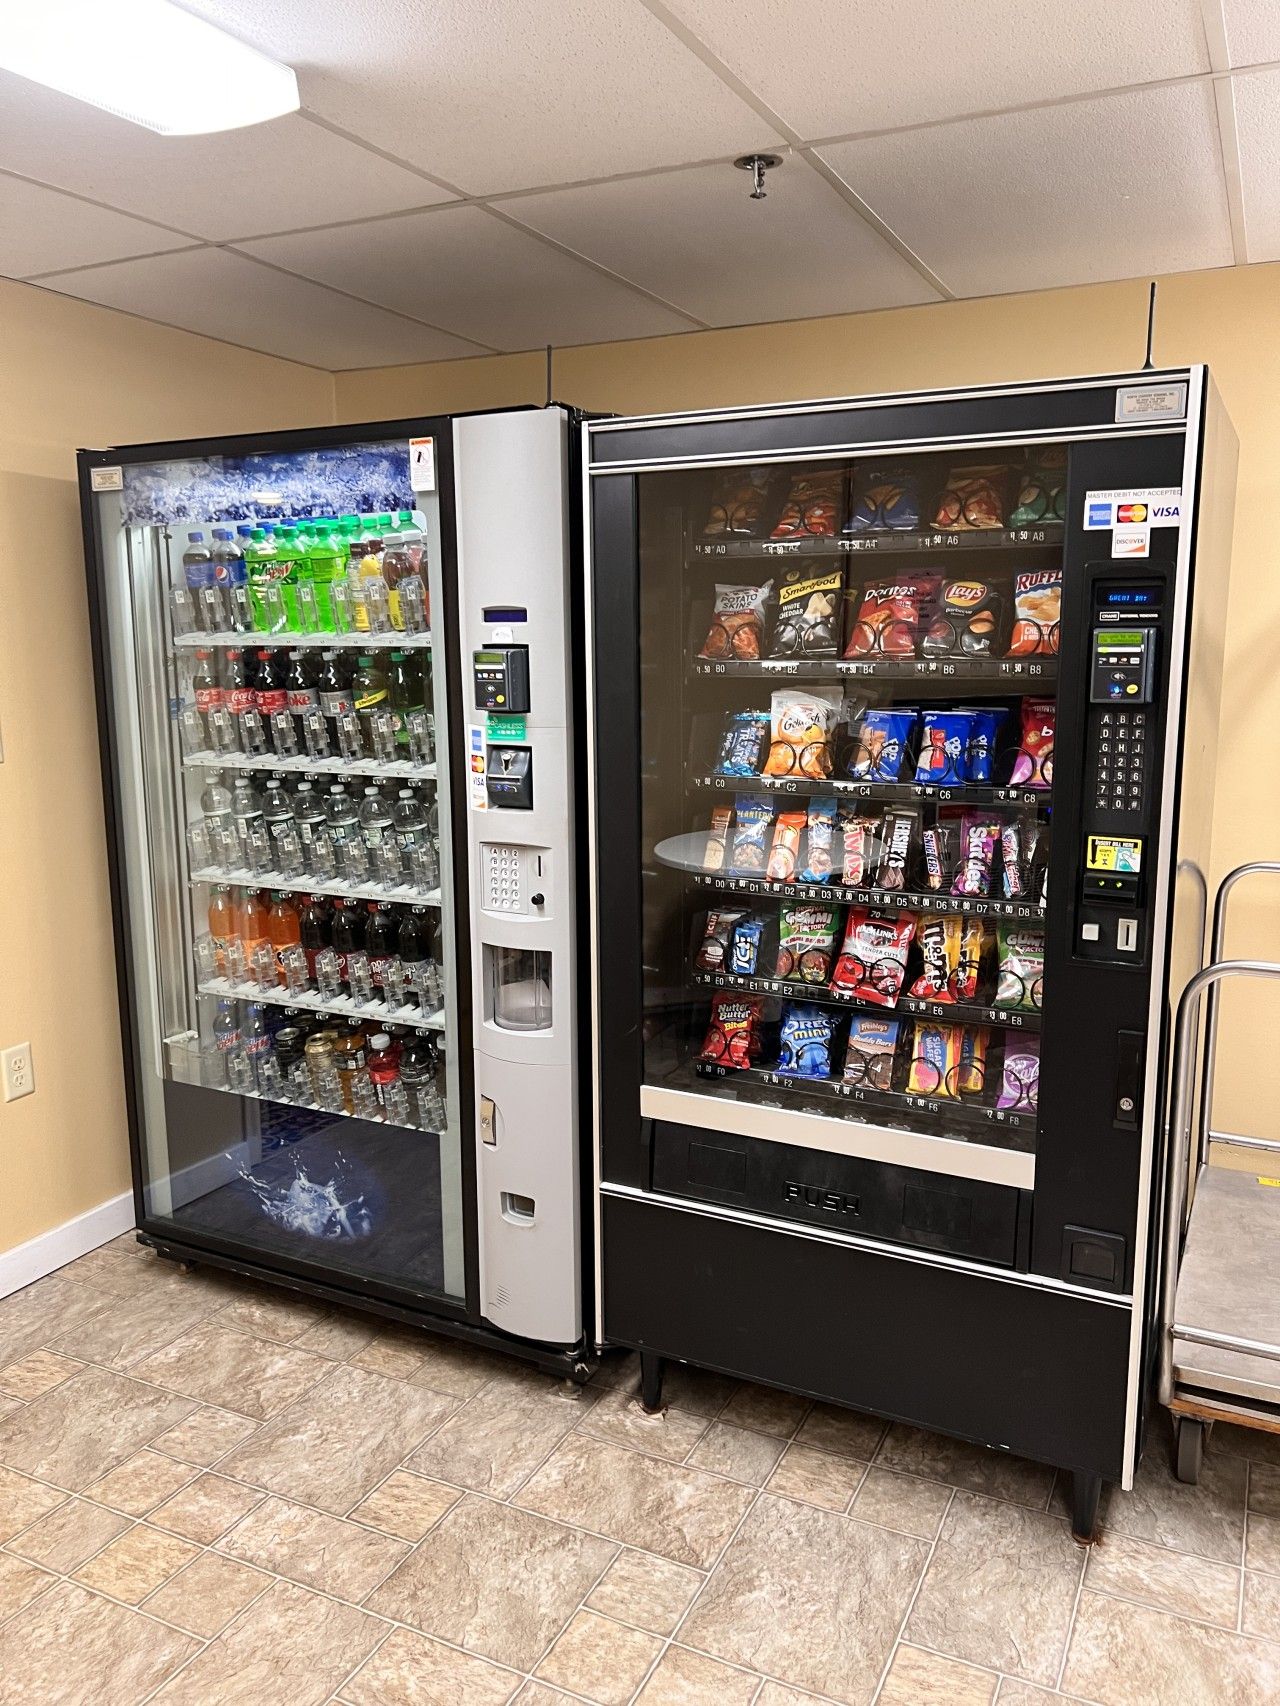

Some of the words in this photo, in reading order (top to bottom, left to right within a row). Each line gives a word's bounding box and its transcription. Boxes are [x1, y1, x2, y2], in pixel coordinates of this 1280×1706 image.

[1113, 491, 1132, 499] DEBIT
[1132, 490, 1146, 498] NOT
[1152, 506, 1180, 518] VISA
[947, 536, 959, 545] A6
[1032, 532, 1044, 542] A8
[716, 545, 726, 554] A0
[782, 576, 837, 600] Smartfood
[720, 593, 758, 603] POTATO
[864, 586, 918, 603] Doritos
[722, 601, 752, 610] SKINS
[782, 602, 801, 612] WHITE
[778, 608, 804, 620] CHEDDAR
[715, 664, 726, 673] B0
[787, 666, 798, 674] B2
[863, 665, 874, 674] B4
[943, 665, 955, 674] B6
[1030, 665, 1042, 674] B8
[715, 778, 725, 788] C0
[786, 782, 797, 792] C2
[860, 786, 870, 796] C4
[940, 790, 951, 800] C6
[1024, 793, 1036, 804] C8
[844, 826, 864, 878] TWIX
[923, 830, 938, 875] SNICKERS
[715, 878, 725, 888] D0
[750, 882, 759, 892] D1
[784, 886, 795, 896] D2
[821, 890, 832, 900] D3
[858, 894, 869, 902] D4
[896, 897, 908, 906] D5
[936, 900, 948, 910] D6
[976, 904, 988, 914] D7
[870, 910, 881, 918] 70
[1018, 908, 1030, 917] D8
[735, 934, 751, 968] ICE
[714, 977, 724, 986] E0
[750, 982, 758, 990] E1
[783, 986, 793, 996] E2
[718, 1003, 750, 1013] Nutter
[933, 1006, 944, 1016] E6
[719, 1010, 751, 1020] Butter
[724, 1020, 748, 1031] Bites
[1012, 1016, 1022, 1026] E8
[852, 1034, 876, 1045] Buddy
[875, 1038, 893, 1047] Bars
[932, 1036, 942, 1067] SUGAR
[716, 1067, 726, 1076] F0
[784, 1079, 793, 1088] F2
[855, 1091, 864, 1100] F4
[928, 1103, 938, 1112] F6
[1009, 1116, 1020, 1126] F8
[784, 1181, 861, 1216] PUSH
